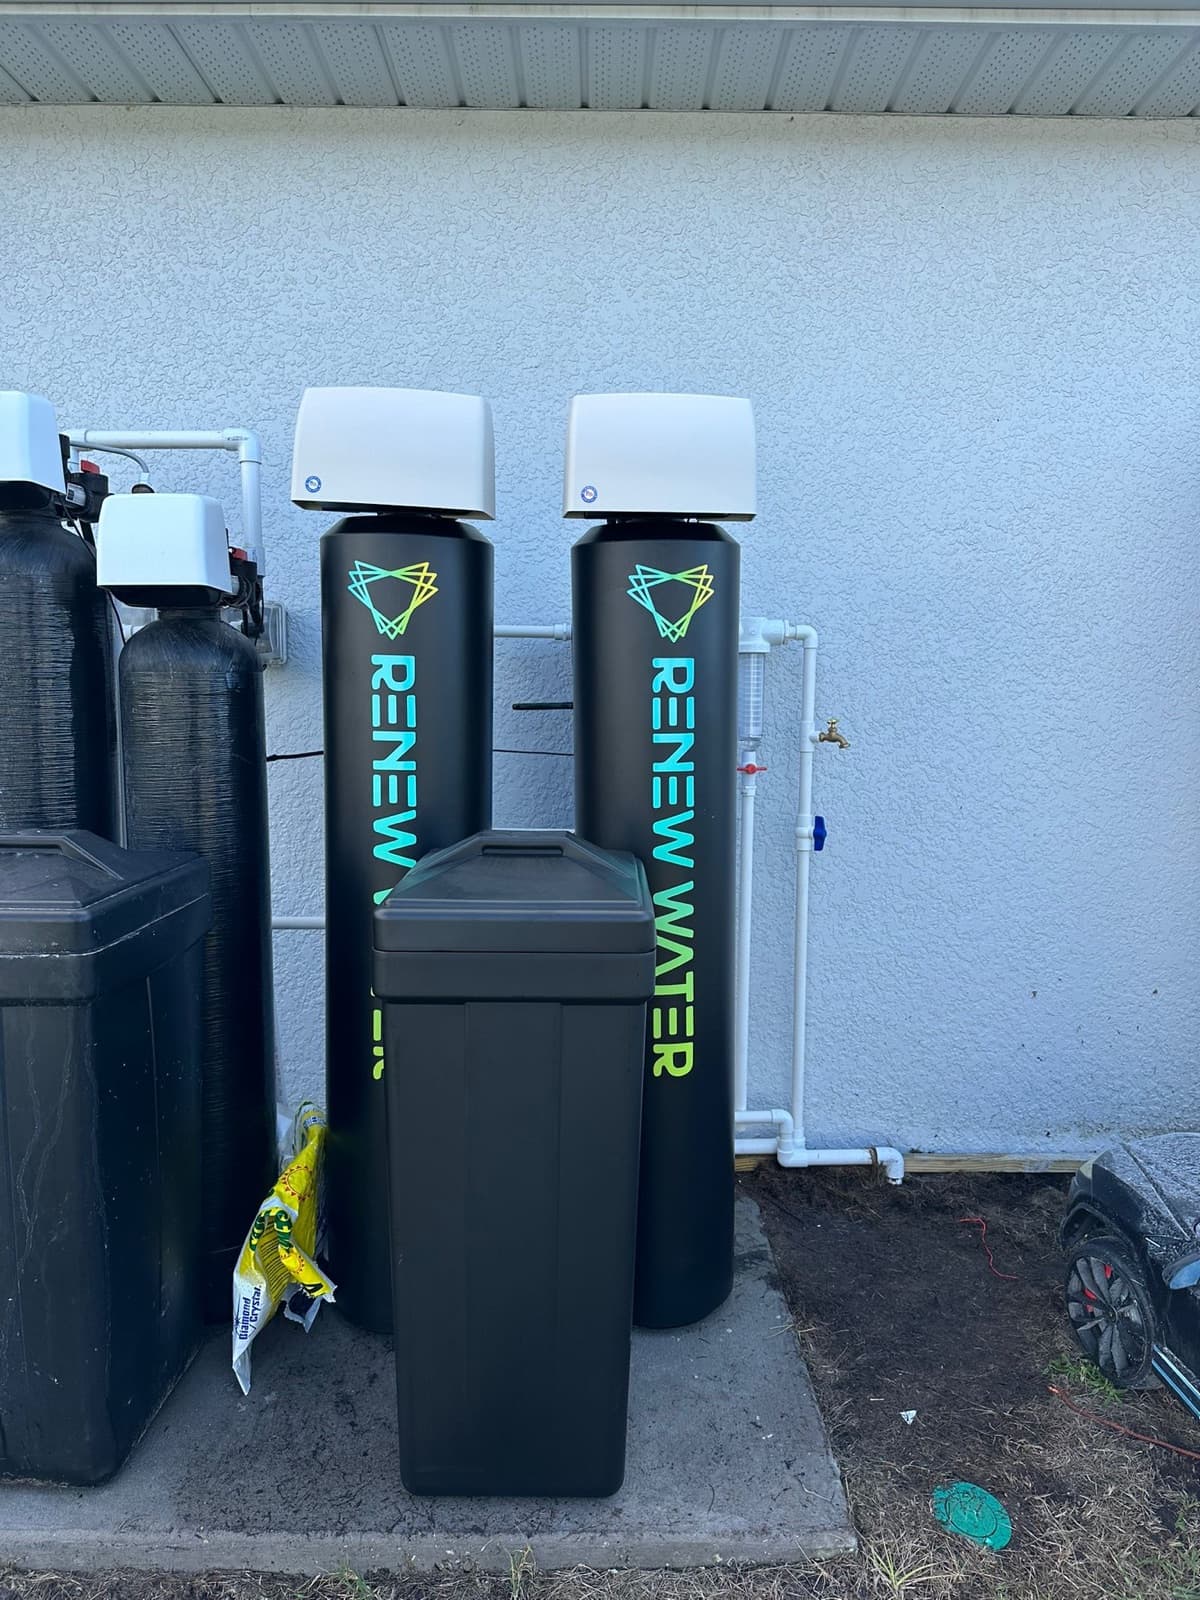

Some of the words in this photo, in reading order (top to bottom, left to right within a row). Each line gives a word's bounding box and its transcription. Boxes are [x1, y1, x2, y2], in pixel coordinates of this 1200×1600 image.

[371, 655, 417, 868] RENEW
[652, 657, 695, 868] RENEW
[652, 880, 695, 1078] WATER
[239, 1296, 251, 1340] Diamond
[250, 1286, 261, 1323] Crystal
